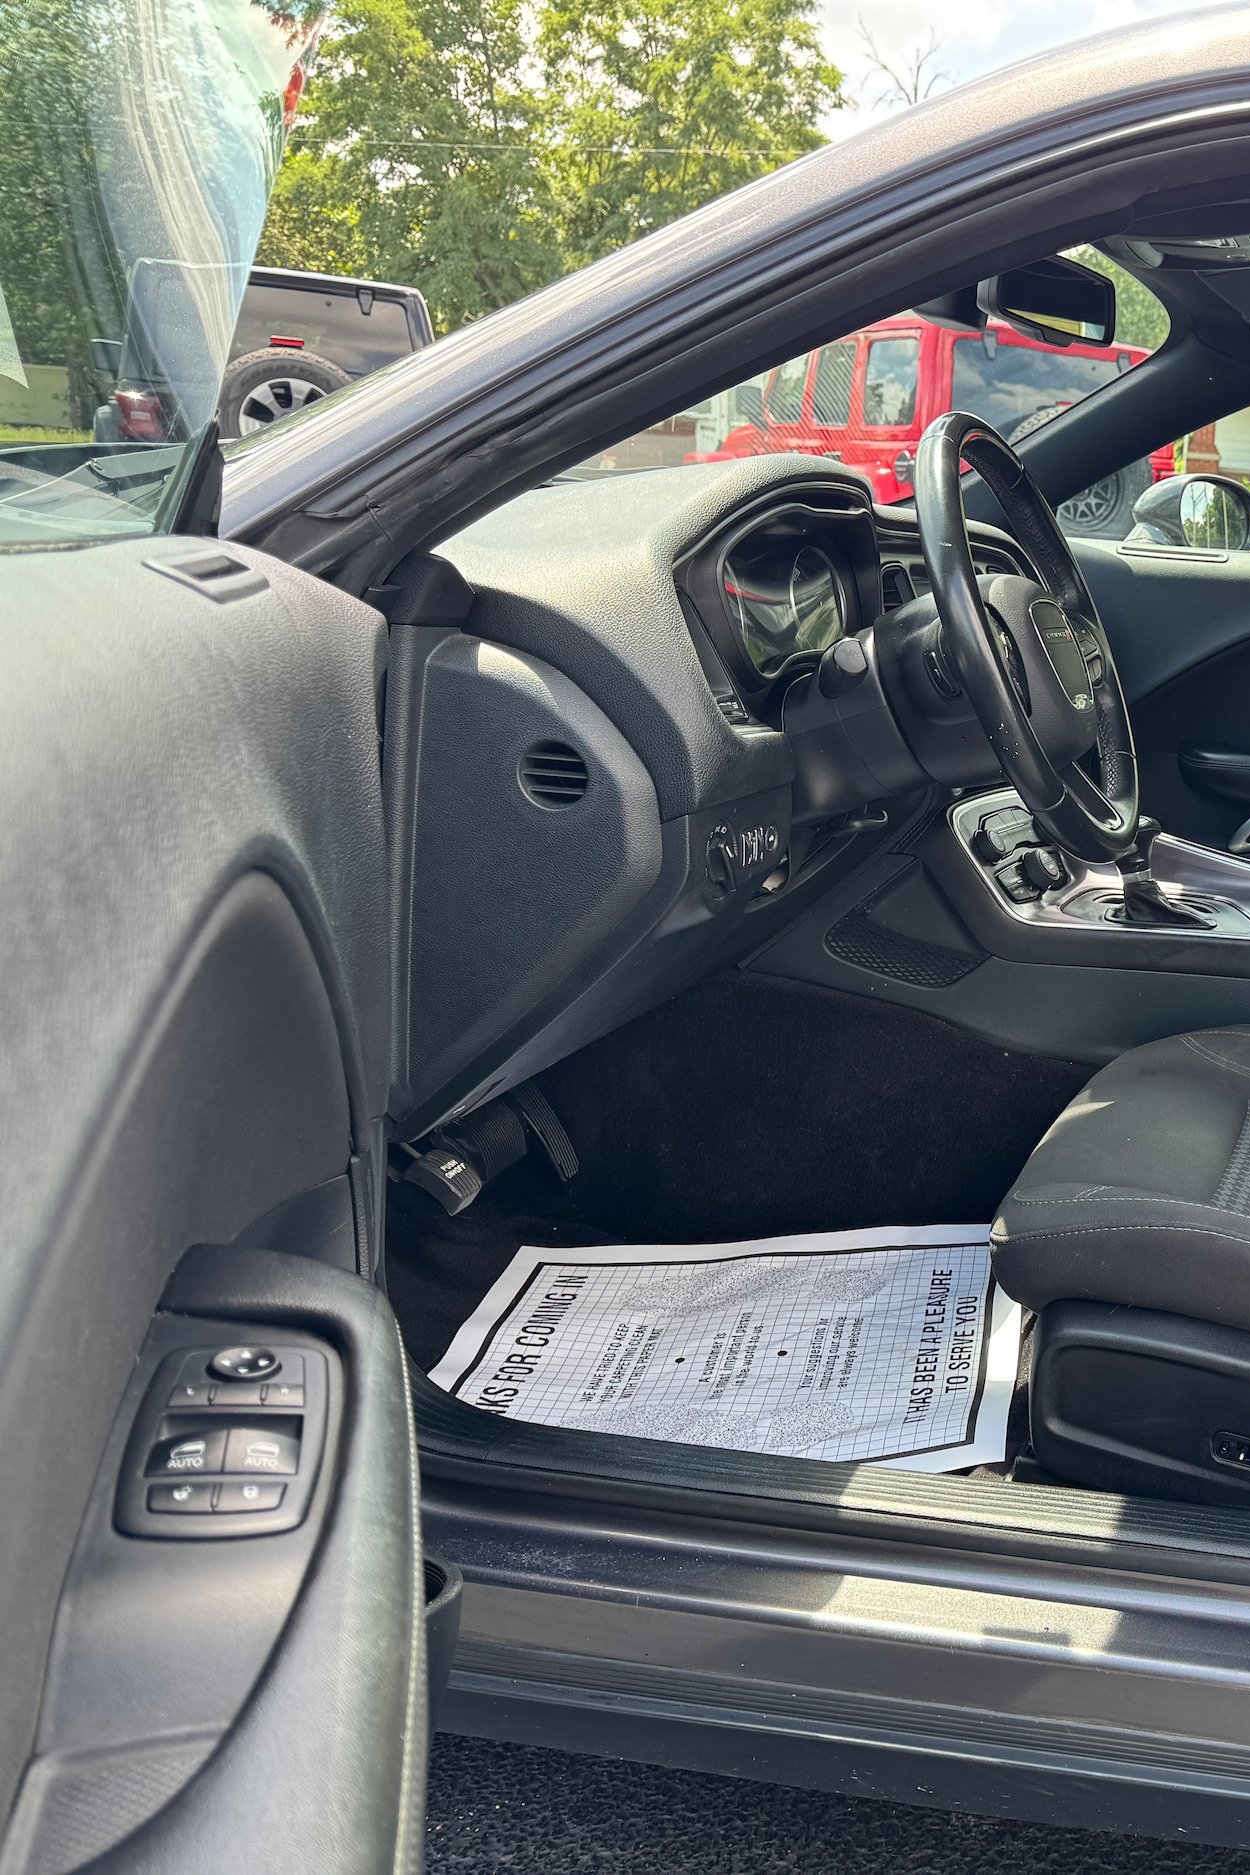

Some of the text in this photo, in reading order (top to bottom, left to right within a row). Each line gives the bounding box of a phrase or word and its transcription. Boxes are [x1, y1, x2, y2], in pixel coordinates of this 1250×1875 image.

[440, 1158, 458, 1171] PUSH
[553, 1275, 588, 1288] IN
[515, 1292, 578, 1347] COMING
[735, 1312, 752, 1334] person
[747, 1335, 760, 1343] to
[903, 1269, 953, 1424] IT HAS BEEN A PLEASURE
[945, 1296, 978, 1394] TO SERVE YOU
[579, 1323, 630, 1402] WE HAVE TRIED TO KEEP
[599, 1325, 648, 1402] YOUR CARPETING CLEAN
[619, 1328, 664, 1400] WITH THIS PAPER MAT
[703, 1341, 723, 1375] customer
[713, 1332, 726, 1340] is
[720, 1335, 744, 1371] important
[742, 1345, 757, 1367] world
[798, 1374, 814, 1389] Your
[806, 1327, 826, 1373] suggestions
[815, 1316, 847, 1391] improving our service
[840, 1350, 858, 1375] always
[492, 1353, 541, 1382] FOR
[715, 1373, 731, 1388] most
[735, 1368, 750, 1379] the
[838, 1376, 850, 1388] are
[167, 1457, 203, 1469] AUTO
[244, 1457, 278, 1467] AUTO
